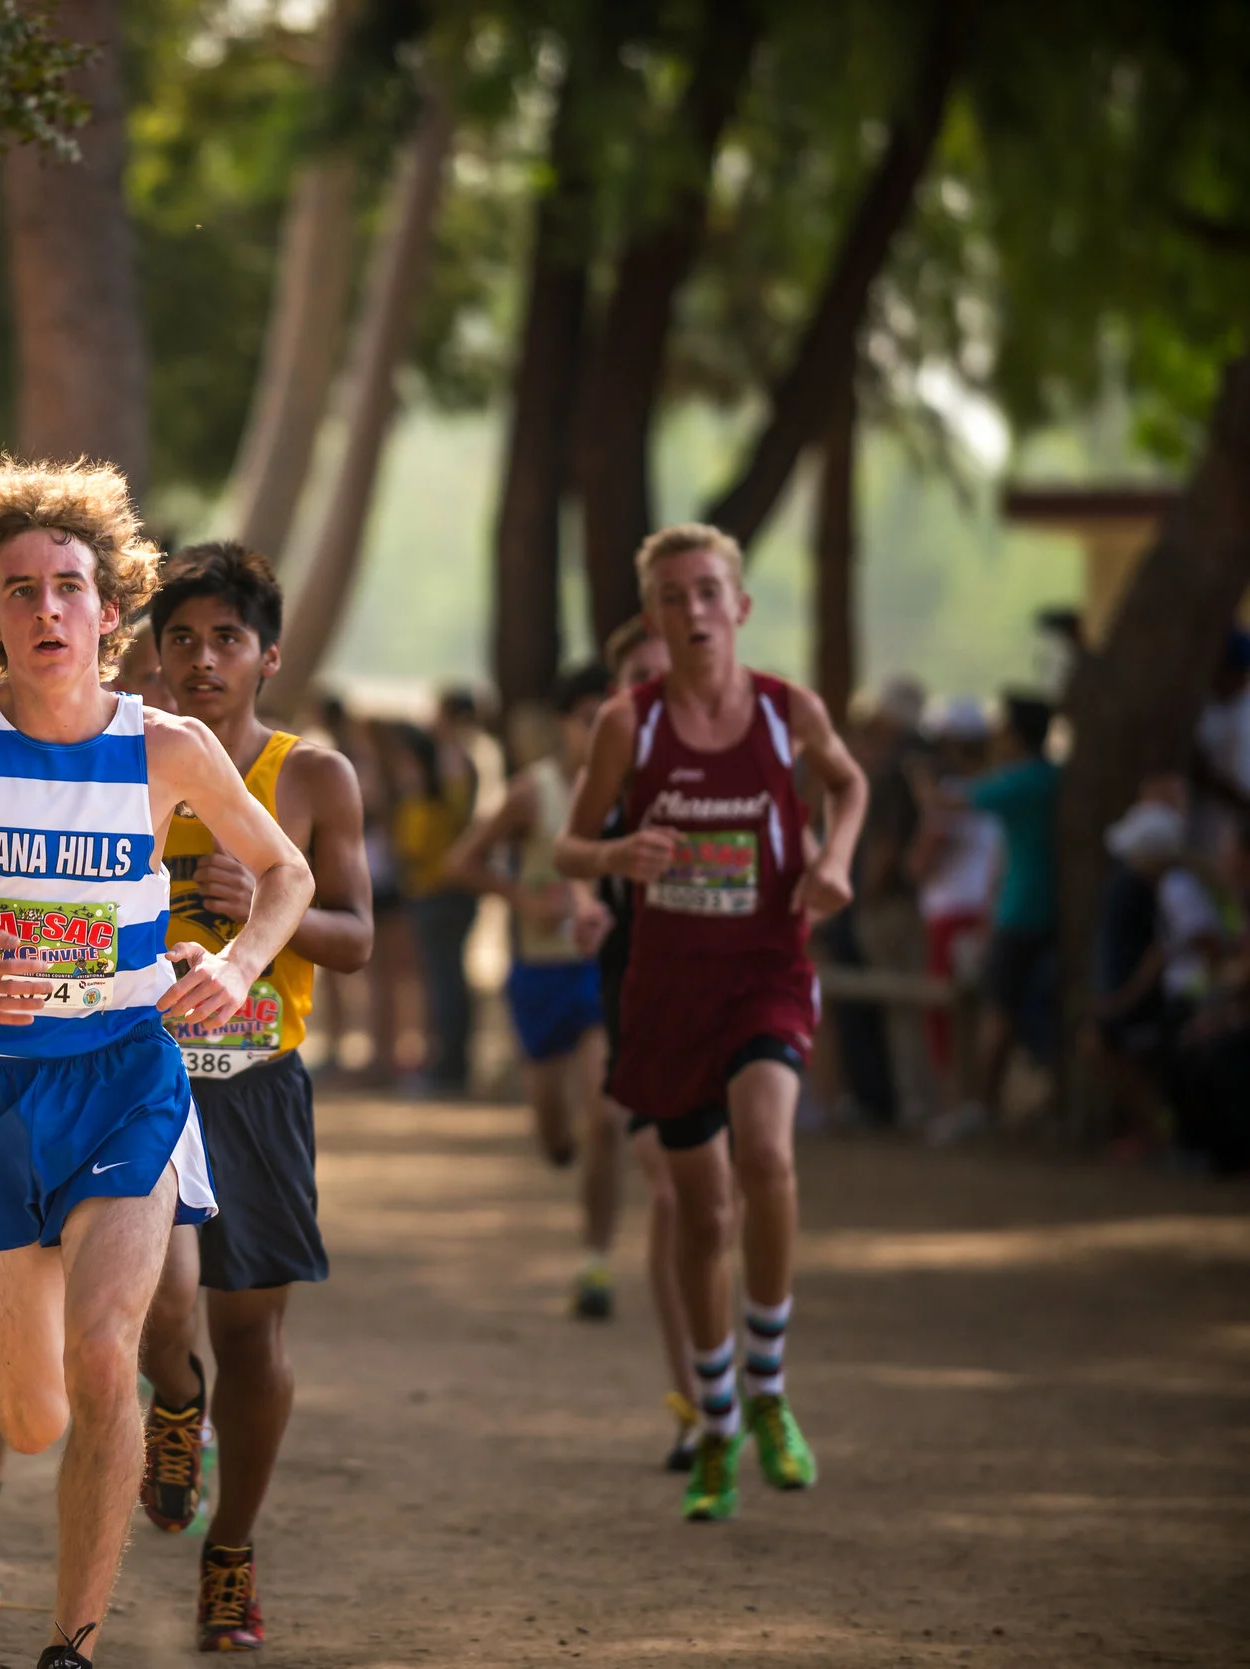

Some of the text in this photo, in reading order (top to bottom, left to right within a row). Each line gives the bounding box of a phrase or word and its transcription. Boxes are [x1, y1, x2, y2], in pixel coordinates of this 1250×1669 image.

[56, 835, 132, 878] HILLS
[41, 947, 100, 963] INVITE
[177, 1021, 209, 1039] XC
[181, 1052, 231, 1073] 386
